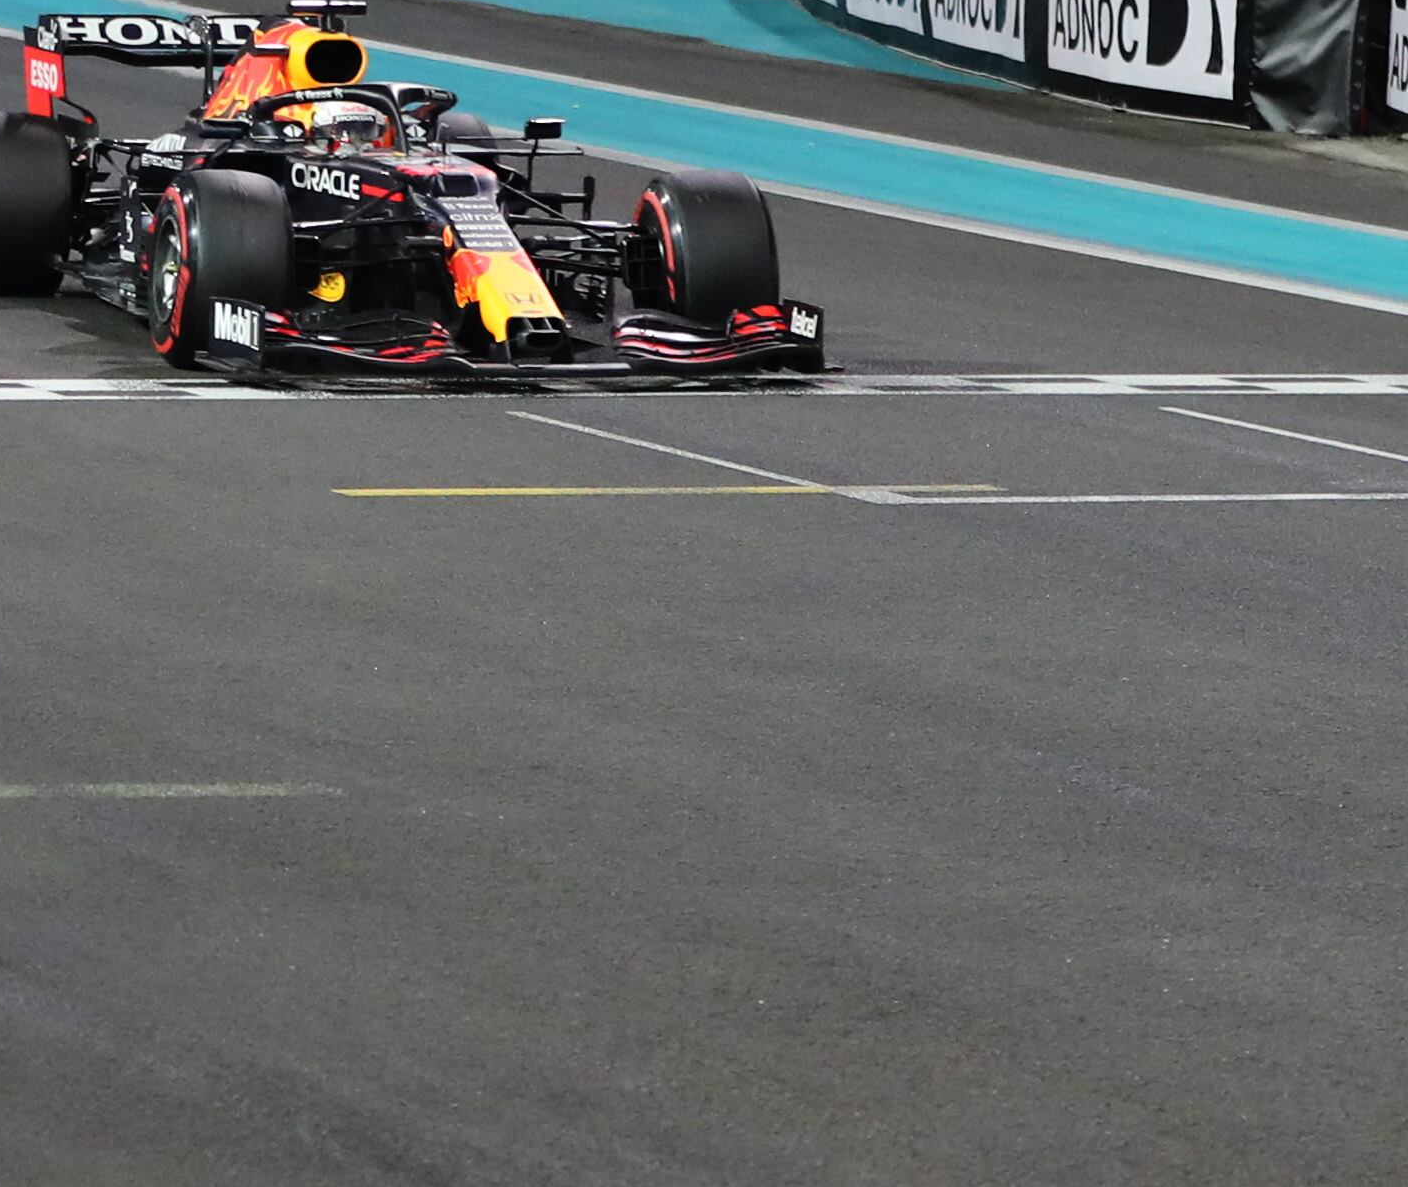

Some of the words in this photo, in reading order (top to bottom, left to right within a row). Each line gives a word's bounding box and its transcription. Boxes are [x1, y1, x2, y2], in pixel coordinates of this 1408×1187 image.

[57, 16, 260, 46] HOND
[31, 59, 58, 93] ESSO
[291, 163, 360, 201] ORACLE
[214, 301, 251, 347] Mobil
